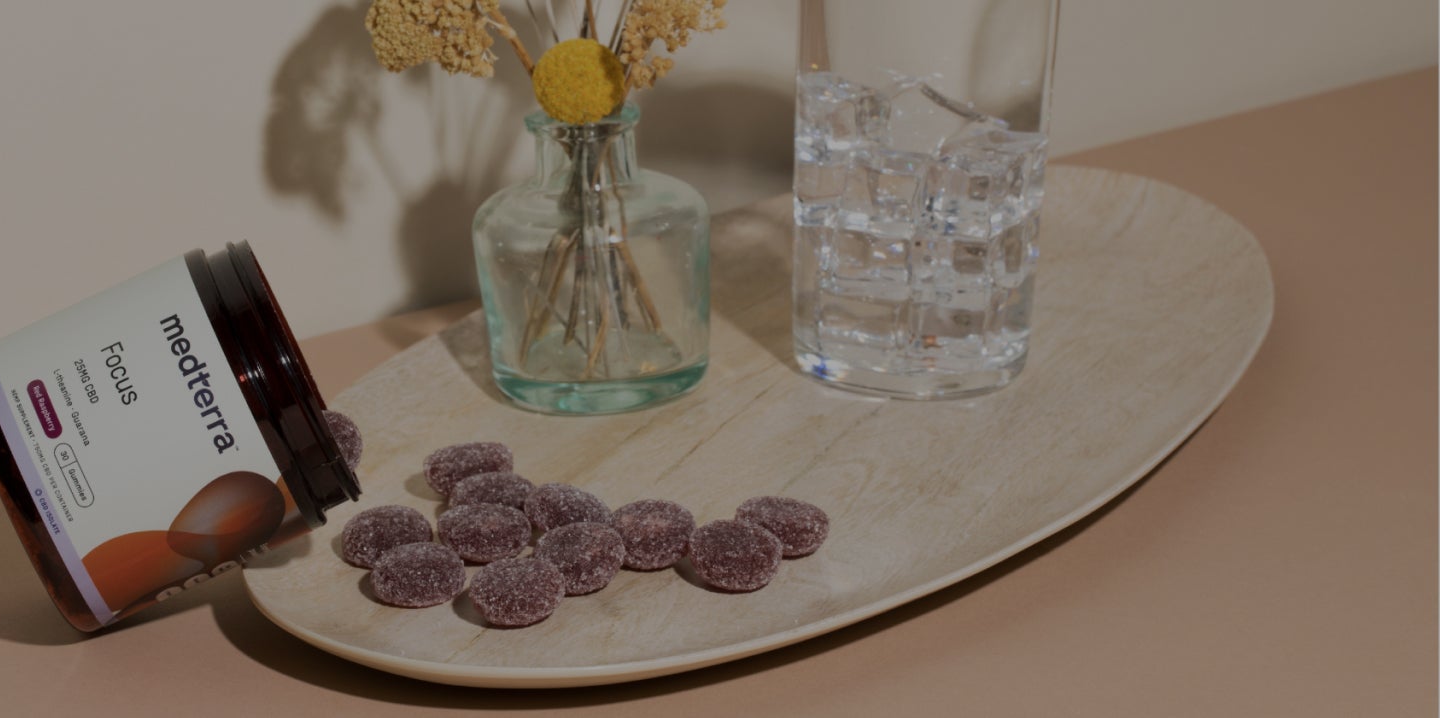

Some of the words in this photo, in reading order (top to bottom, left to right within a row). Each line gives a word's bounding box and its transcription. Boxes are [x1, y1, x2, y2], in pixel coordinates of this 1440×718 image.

[74, 358, 91, 384] 25MG
[84, 384, 99, 404] CBD
[100, 341, 137, 406] Focus
[160, 314, 235, 454] medterra
[38, 397, 56, 432] Raspberry
[53, 368, 73, 407] L-theanine
[71, 411, 90, 446] Guarana
[60, 450, 69, 461] 30
[68, 468, 87, 501] Gummies
